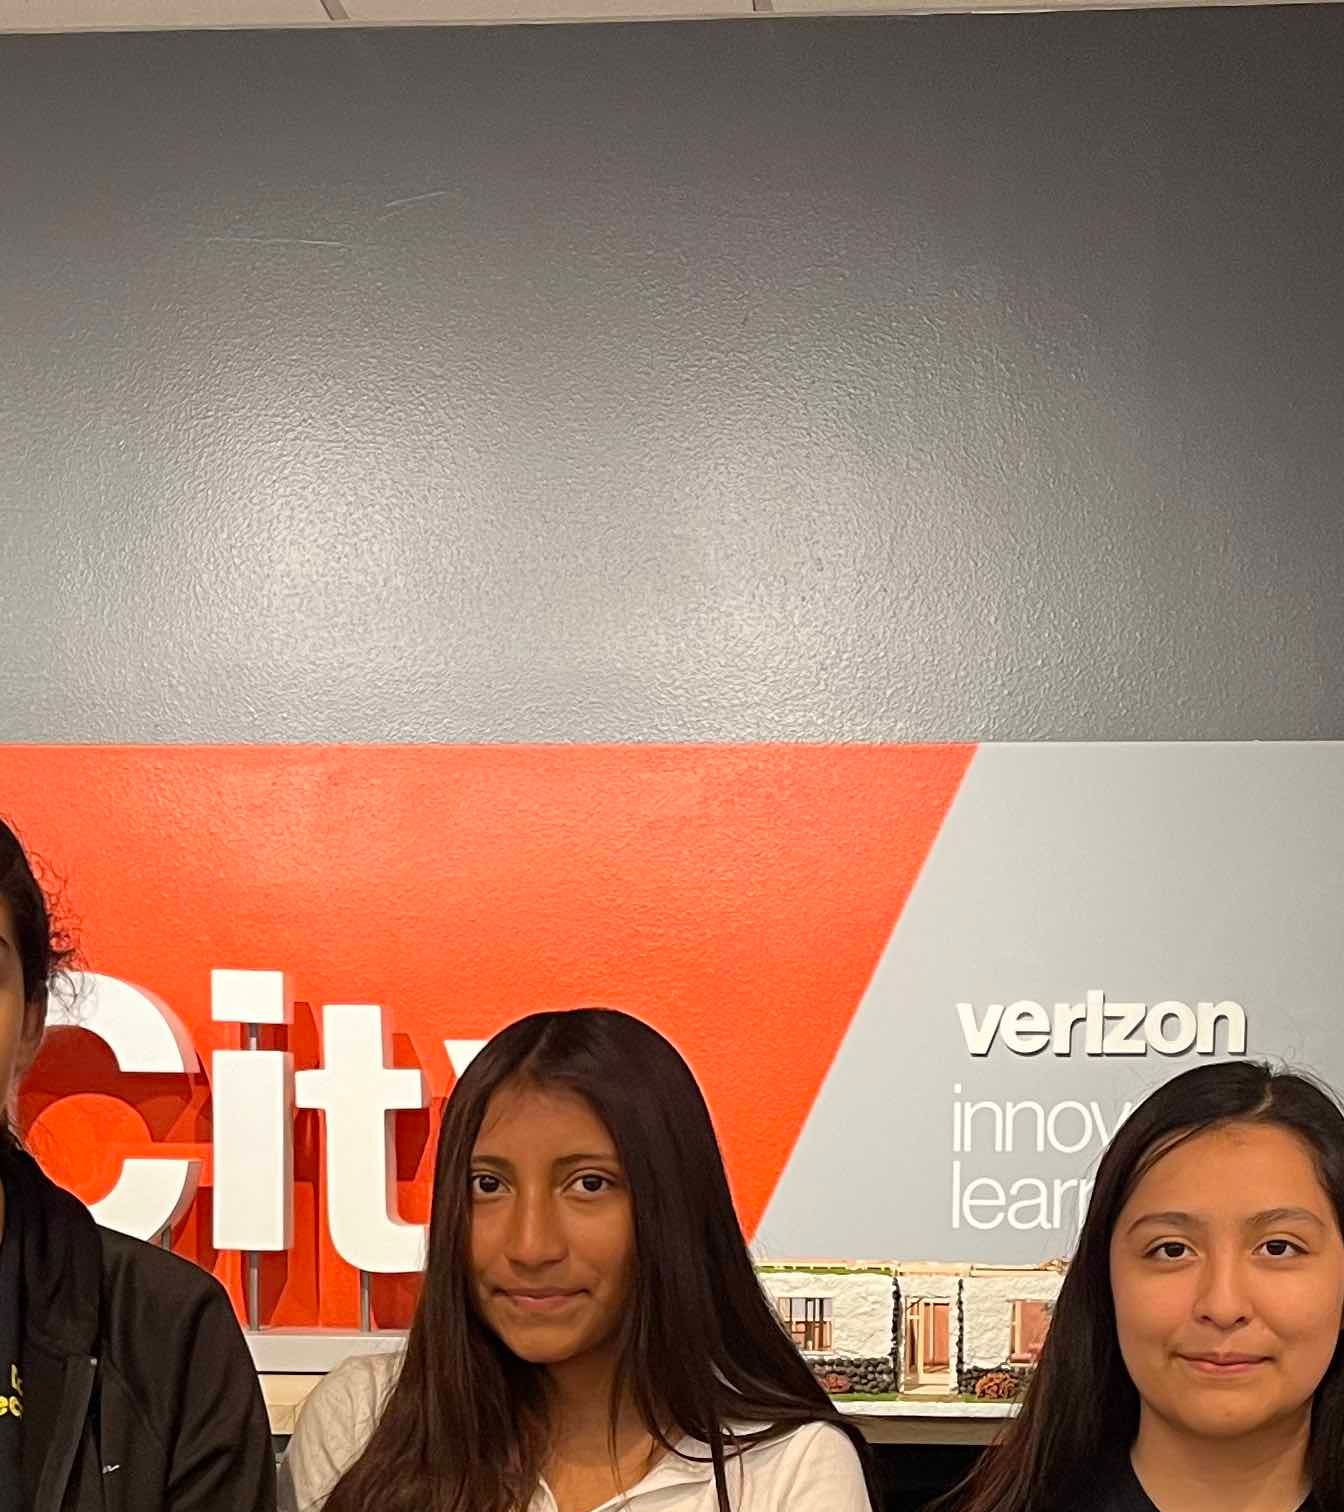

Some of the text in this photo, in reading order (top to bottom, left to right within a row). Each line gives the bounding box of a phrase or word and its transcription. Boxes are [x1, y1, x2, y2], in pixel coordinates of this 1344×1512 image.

[955, 989, 1248, 1057] verizon
[44, 969, 494, 1273] Cit
[952, 1083, 1134, 1153] innov
